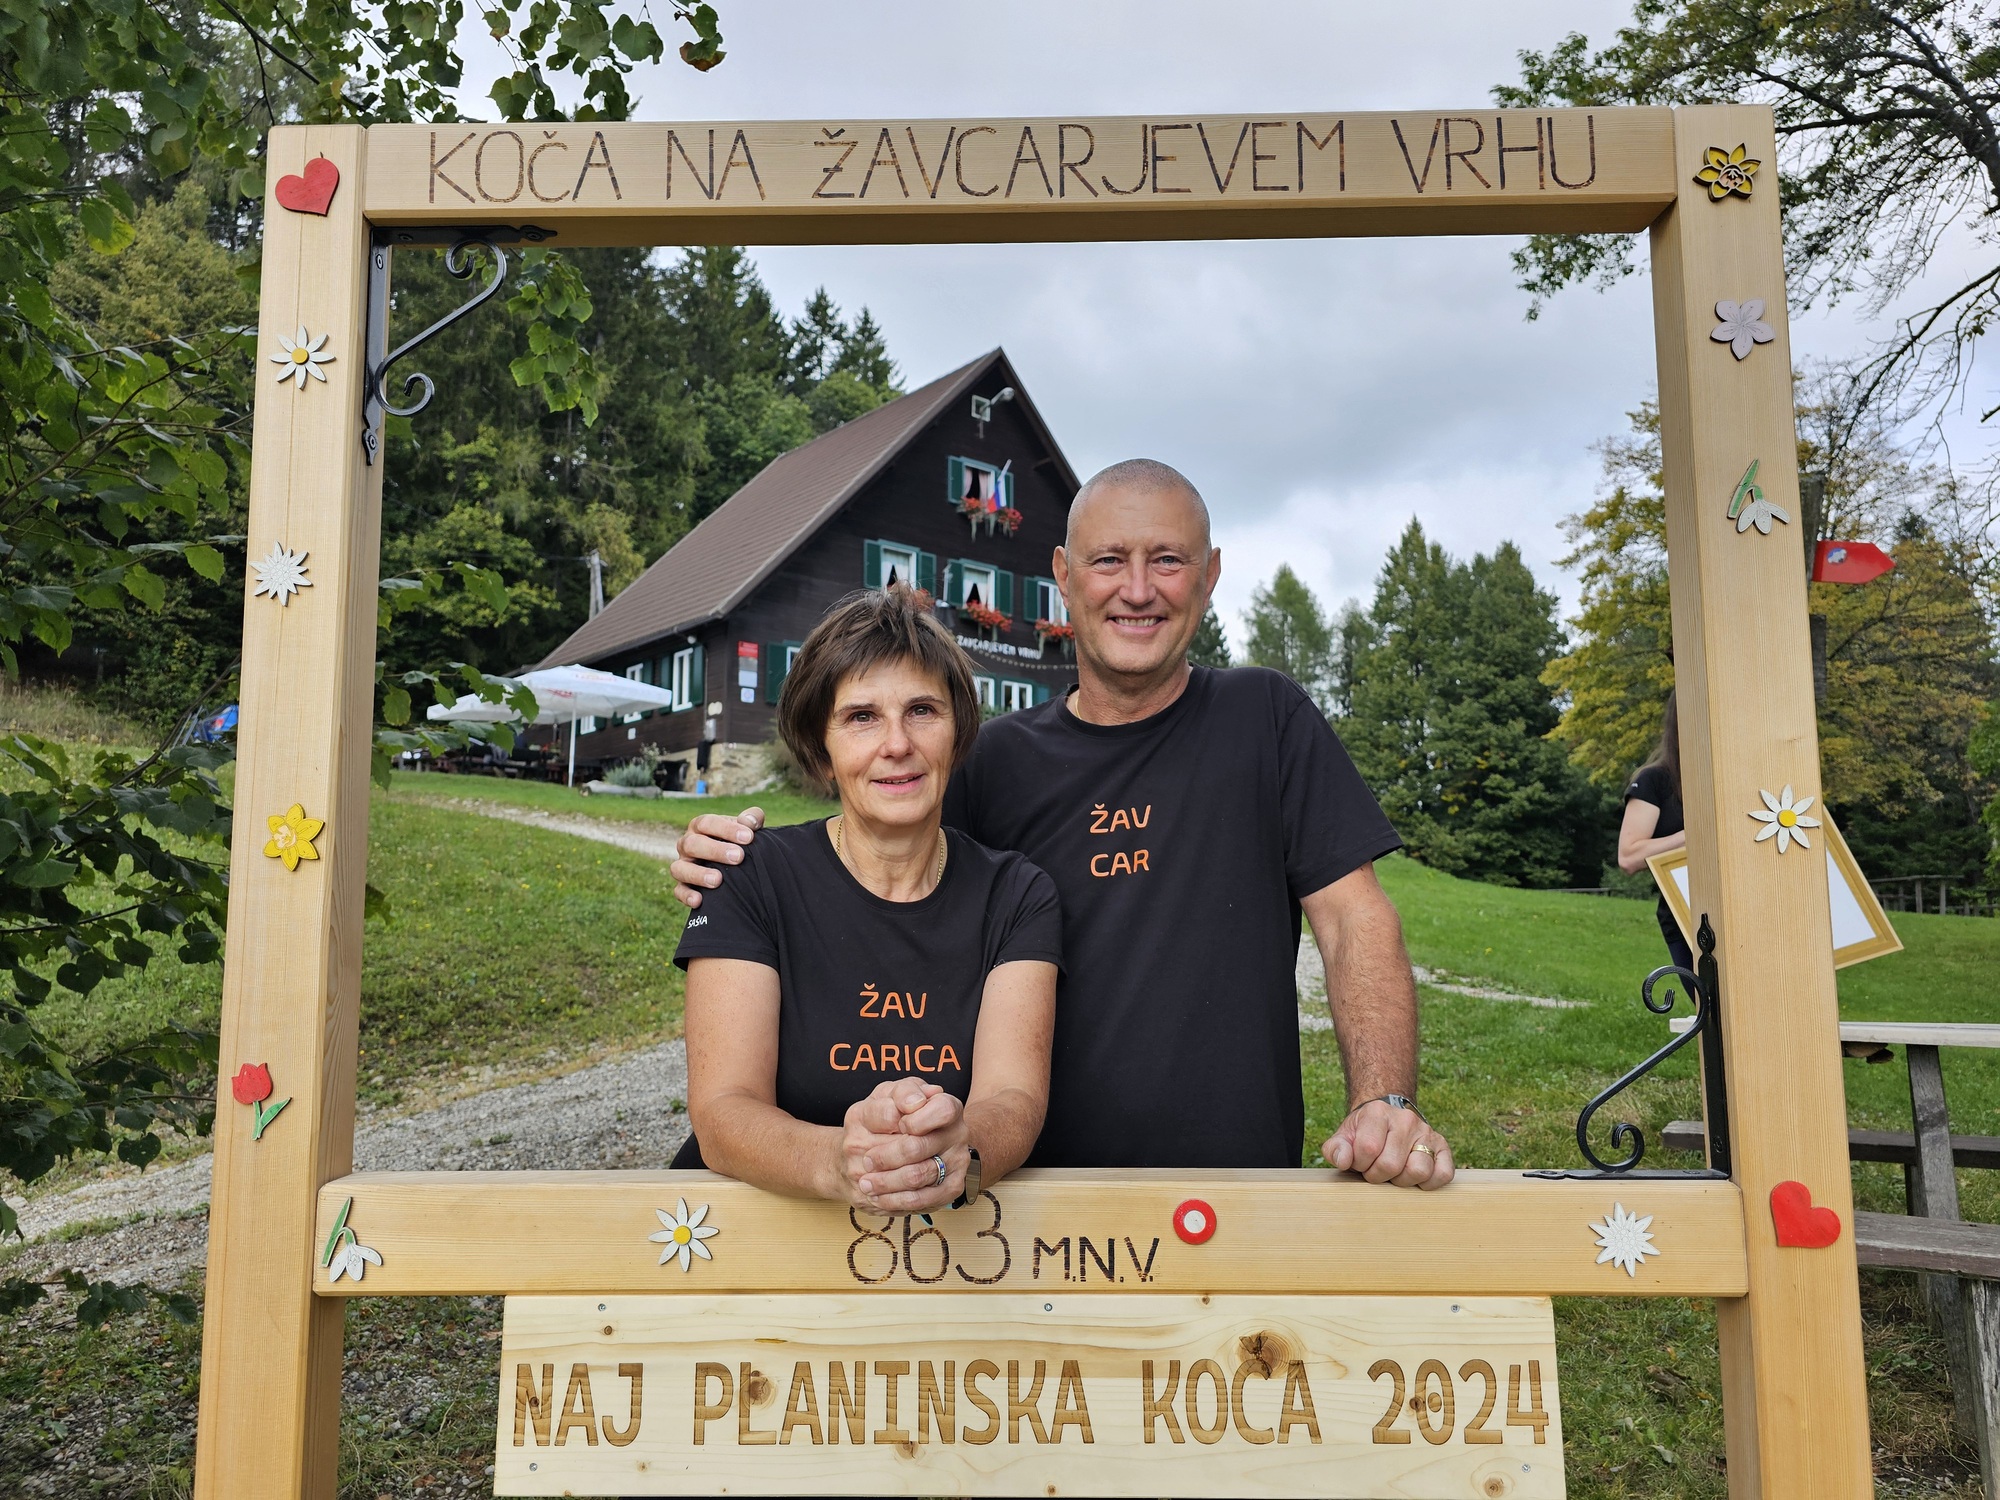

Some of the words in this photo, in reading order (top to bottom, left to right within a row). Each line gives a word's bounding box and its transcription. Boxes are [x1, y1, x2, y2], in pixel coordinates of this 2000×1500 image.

[428, 130, 622, 204] KOČA
[665, 128, 766, 201] NA
[810, 117, 1346, 200] ŽAVCARJEVEM
[1390, 114, 1596, 195] VRHU
[1089, 803, 1152, 834] ŽAV
[1090, 849, 1150, 878] CAR
[859, 983, 927, 1019] ŽAV
[829, 1043, 962, 1072] CARICA
[846, 1189, 1011, 1285] 863
[1032, 1236, 1160, 1283] M.N.V.
[512, 1362, 644, 1447] NAJ
[692, 1358, 1095, 1446] PLANINSKA
[1366, 1358, 1550, 1445] 2024
